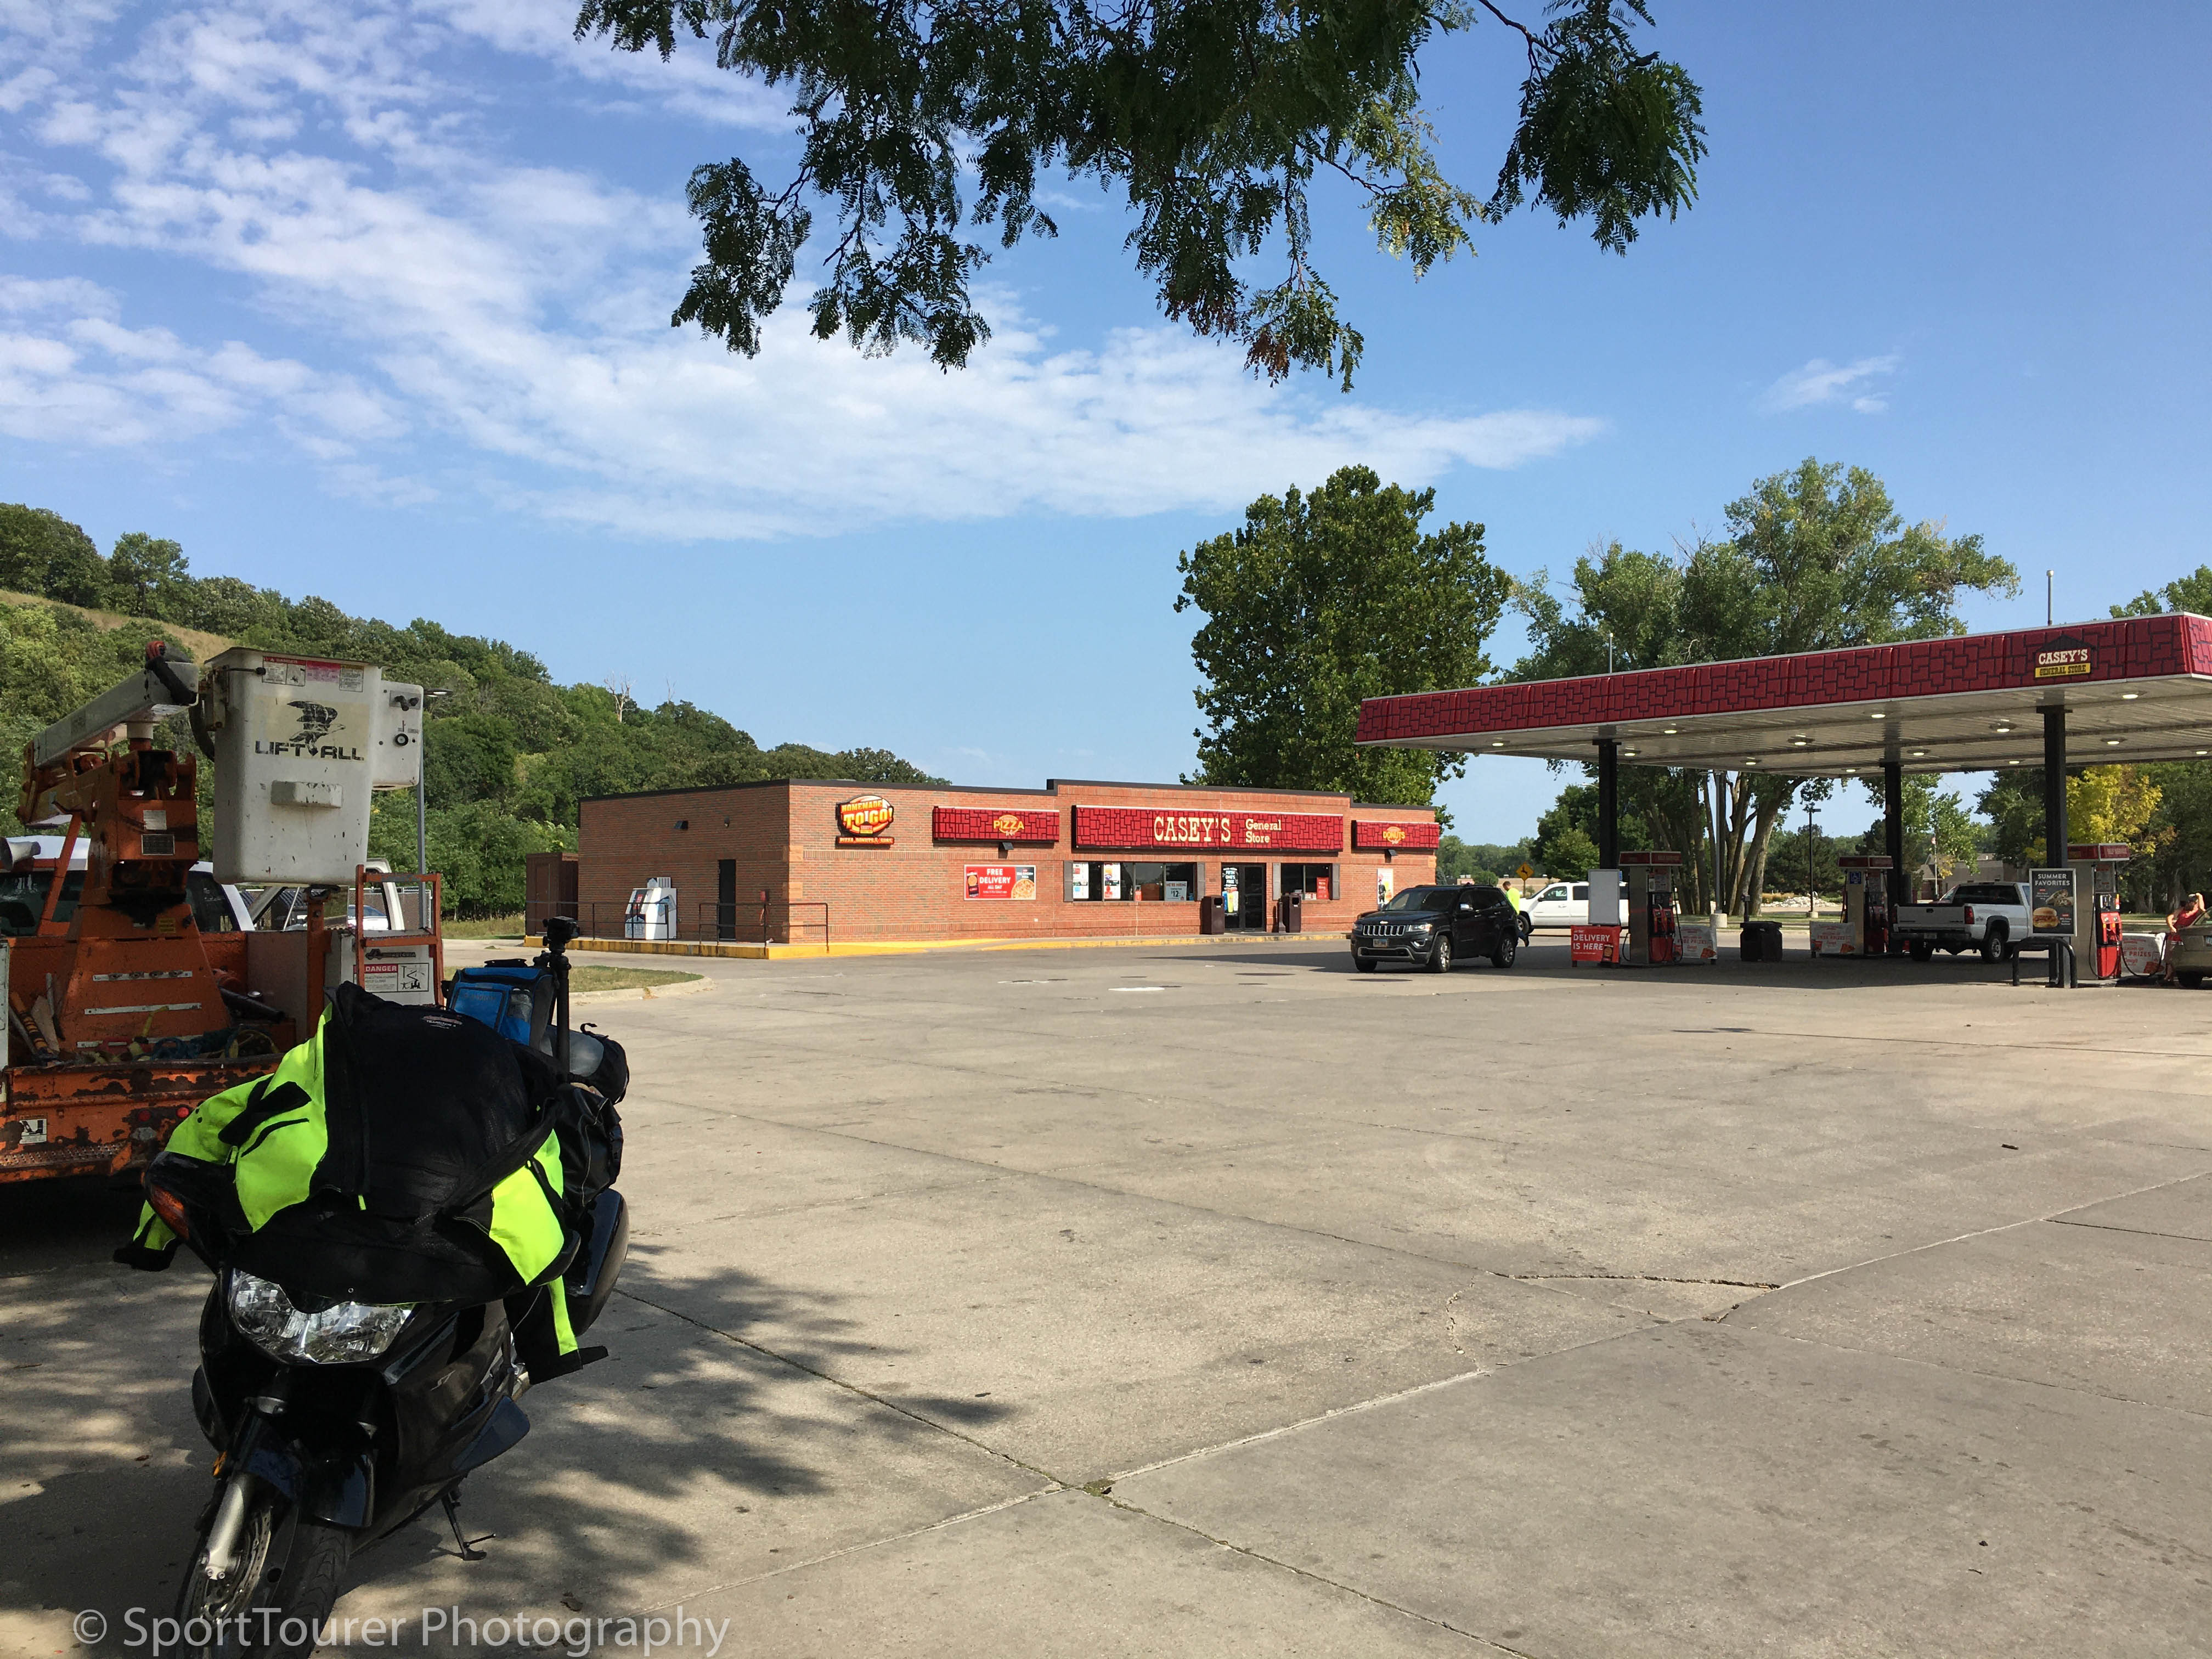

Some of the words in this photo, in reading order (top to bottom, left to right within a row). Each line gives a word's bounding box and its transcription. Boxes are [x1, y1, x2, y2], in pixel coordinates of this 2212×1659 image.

[2039, 649, 2088, 665] CASEY'S
[2040, 666, 2066, 676] GENERAL
[2068, 664, 2086, 673] STORE
[255, 741, 306, 757] LIFT
[320, 745, 364, 761] ALL
[841, 800, 882, 812] HOMEMADE
[843, 811, 865, 828] TO
[994, 820, 1024, 830] PIZZA
[1245, 819, 1282, 831] General
[1154, 816, 1231, 842] CASEY'S
[1383, 831, 1406, 839] DONUTS
[1245, 831, 1270, 843] Store
[1573, 934, 1610, 942] DELIVERY
